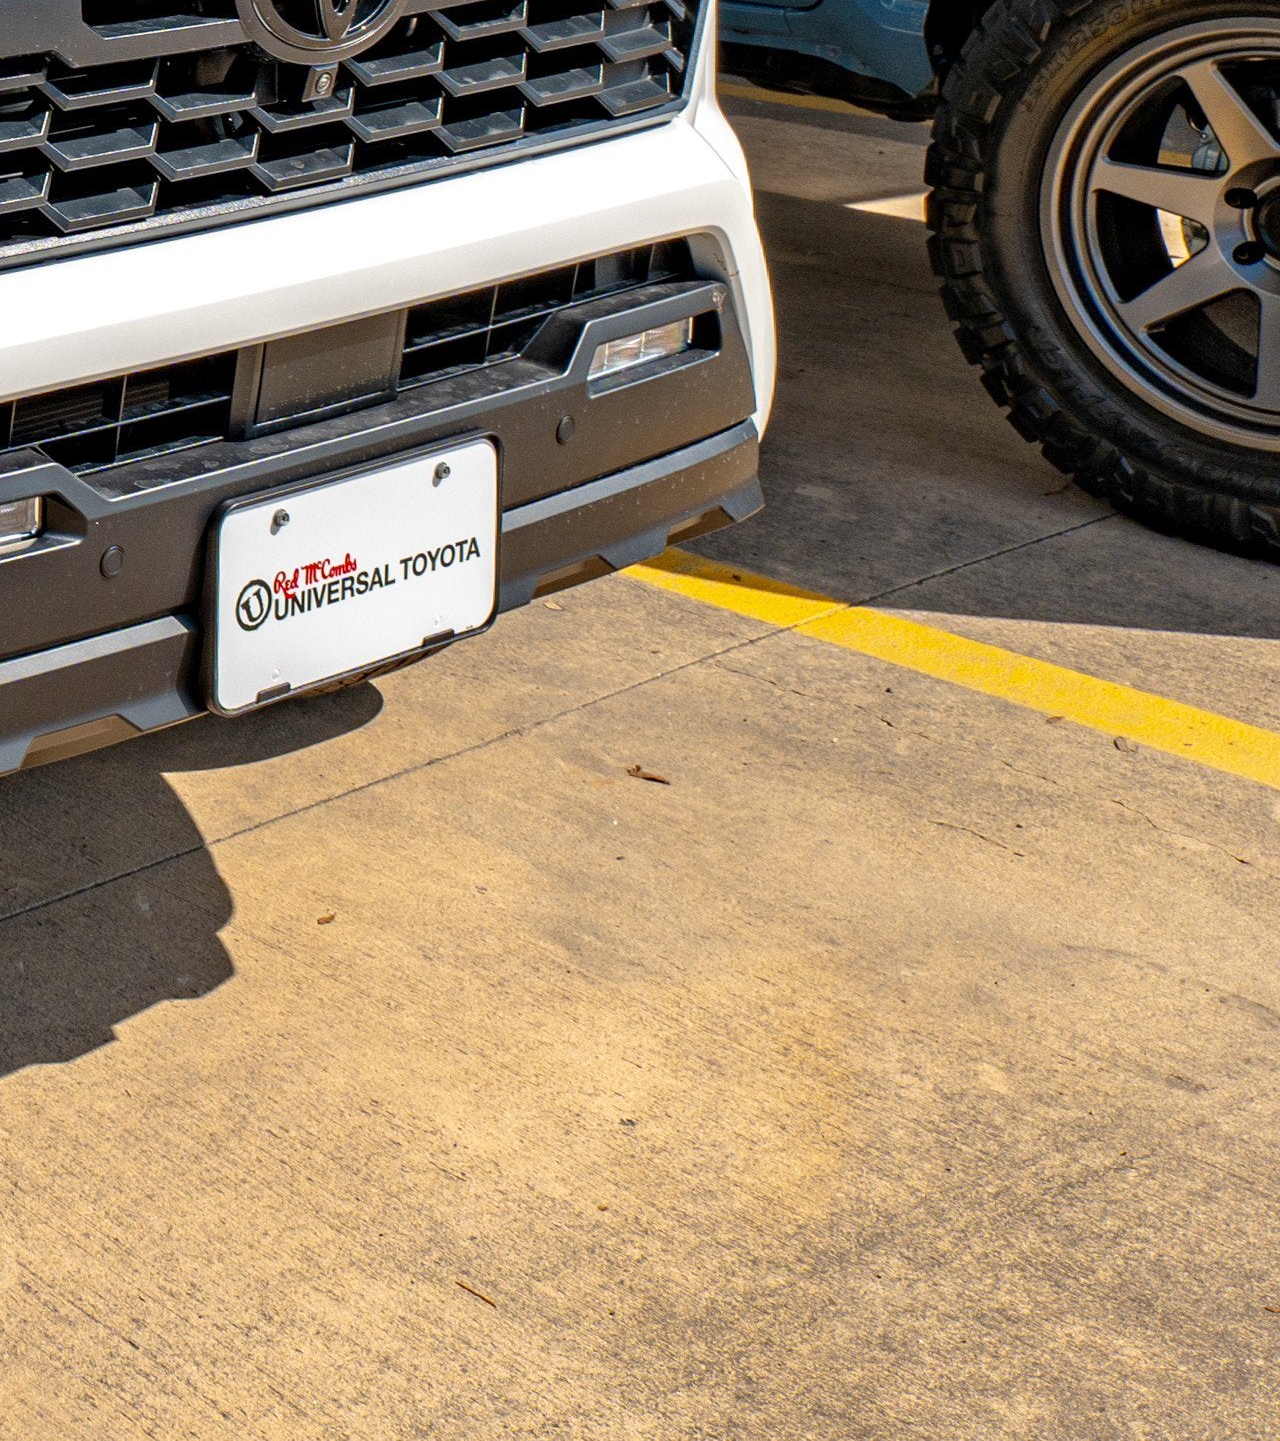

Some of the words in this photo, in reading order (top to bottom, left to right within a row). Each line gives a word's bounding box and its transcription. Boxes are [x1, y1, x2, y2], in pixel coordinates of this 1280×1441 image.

[273, 569, 299, 600] Red
[303, 552, 358, 587] McCombs
[273, 562, 396, 621] UNIVERSAL
[400, 536, 481, 582] TOYOTA
